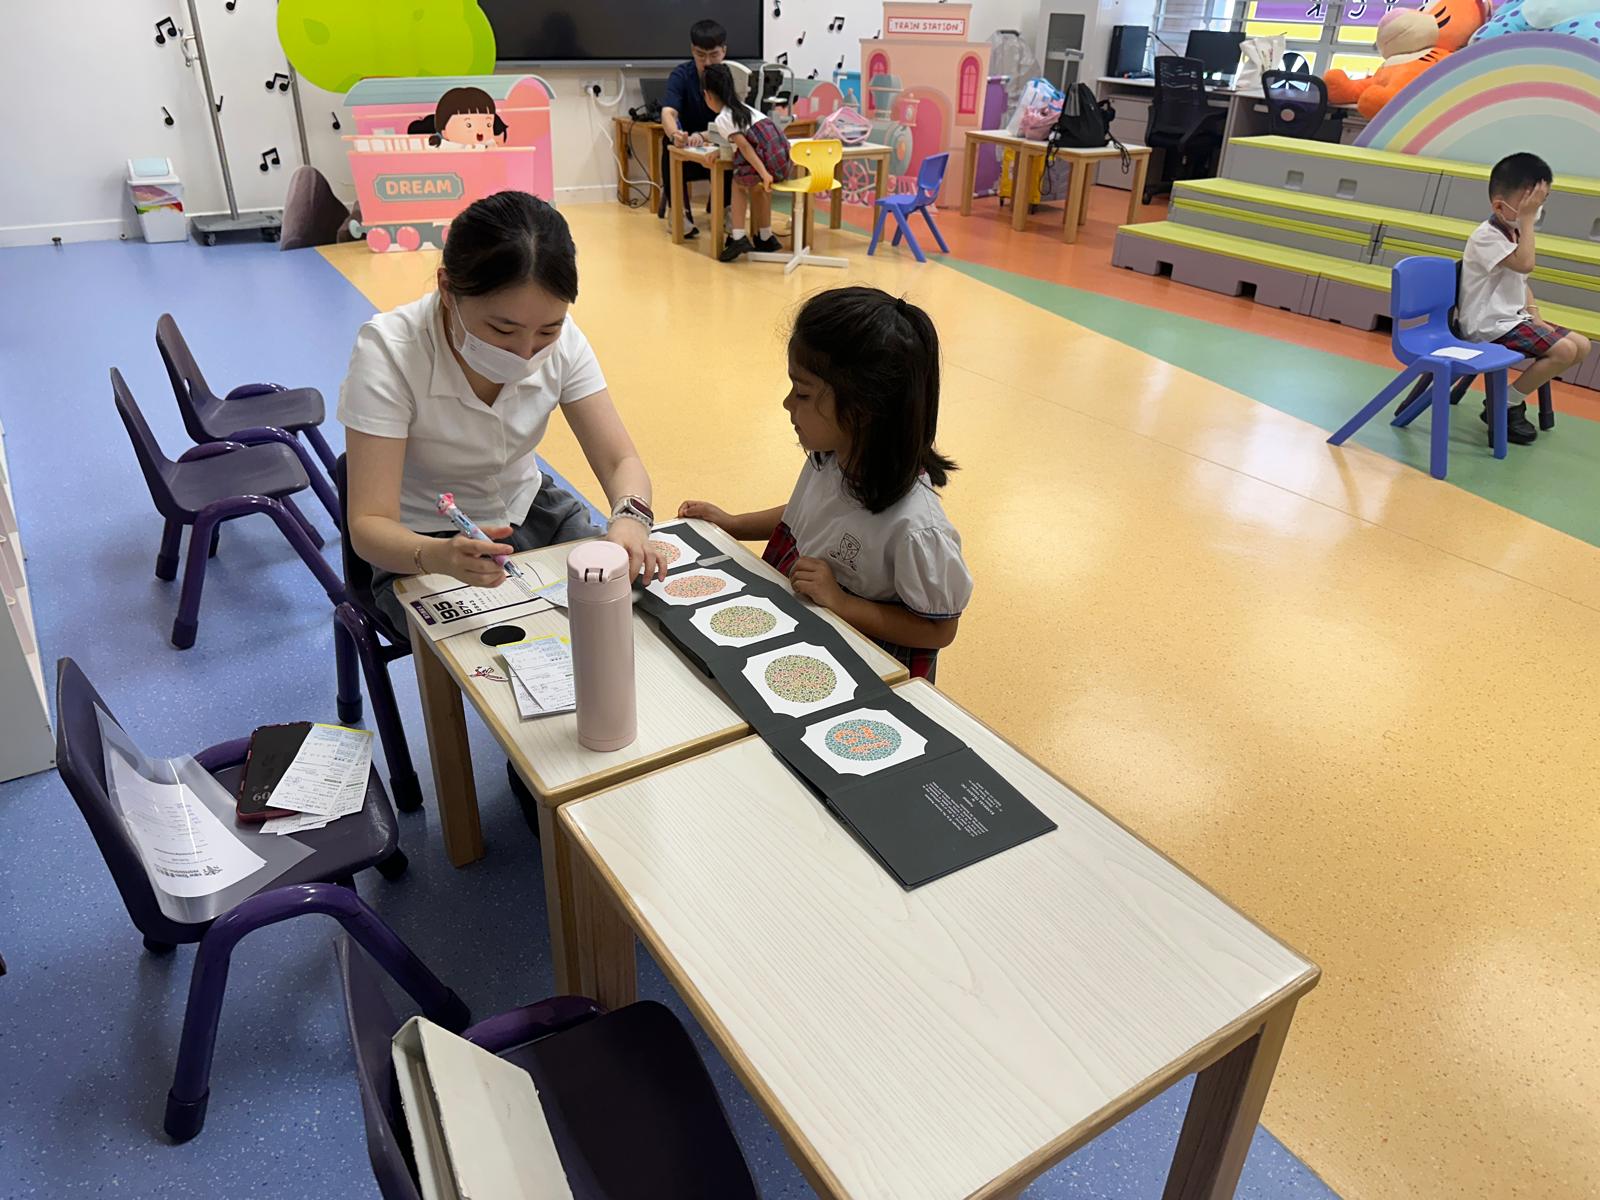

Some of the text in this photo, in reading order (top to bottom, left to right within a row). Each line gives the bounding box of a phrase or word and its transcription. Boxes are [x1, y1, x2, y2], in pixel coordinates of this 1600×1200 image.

[894, 21, 959, 32] TRAIN STATION
[385, 179, 452, 195] DREAM
